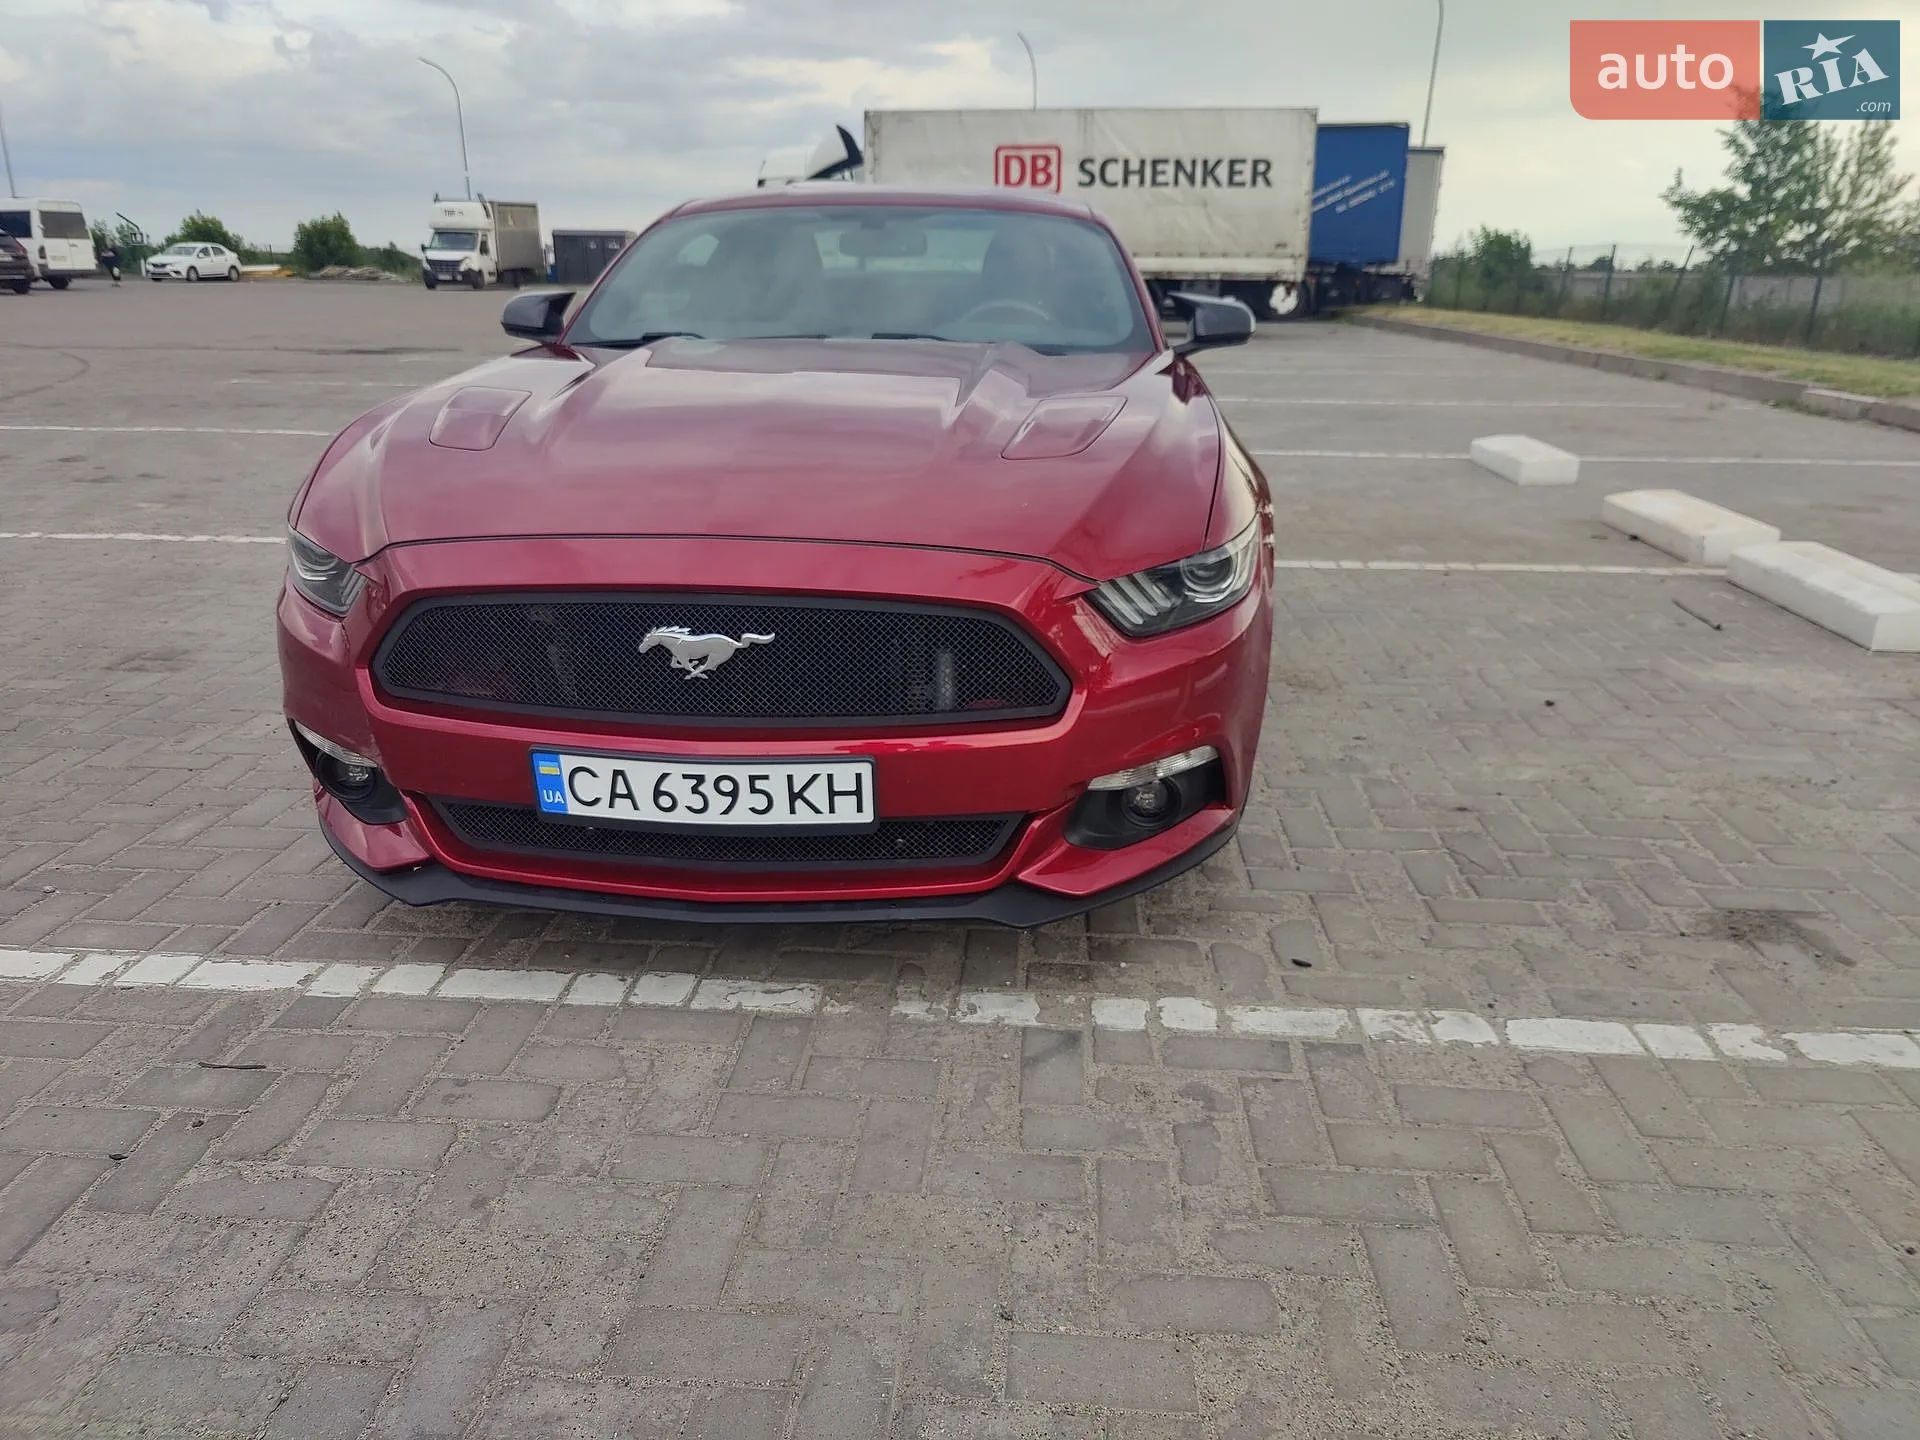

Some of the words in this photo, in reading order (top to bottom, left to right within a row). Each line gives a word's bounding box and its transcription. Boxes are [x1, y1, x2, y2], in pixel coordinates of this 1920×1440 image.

[1003, 154, 1053, 188] DB
[1077, 158, 1273, 189] SCHENKER
[543, 789, 565, 805] UA
[567, 765, 641, 811] CA
[652, 772, 775, 816] 6395
[786, 771, 865, 815] KH
